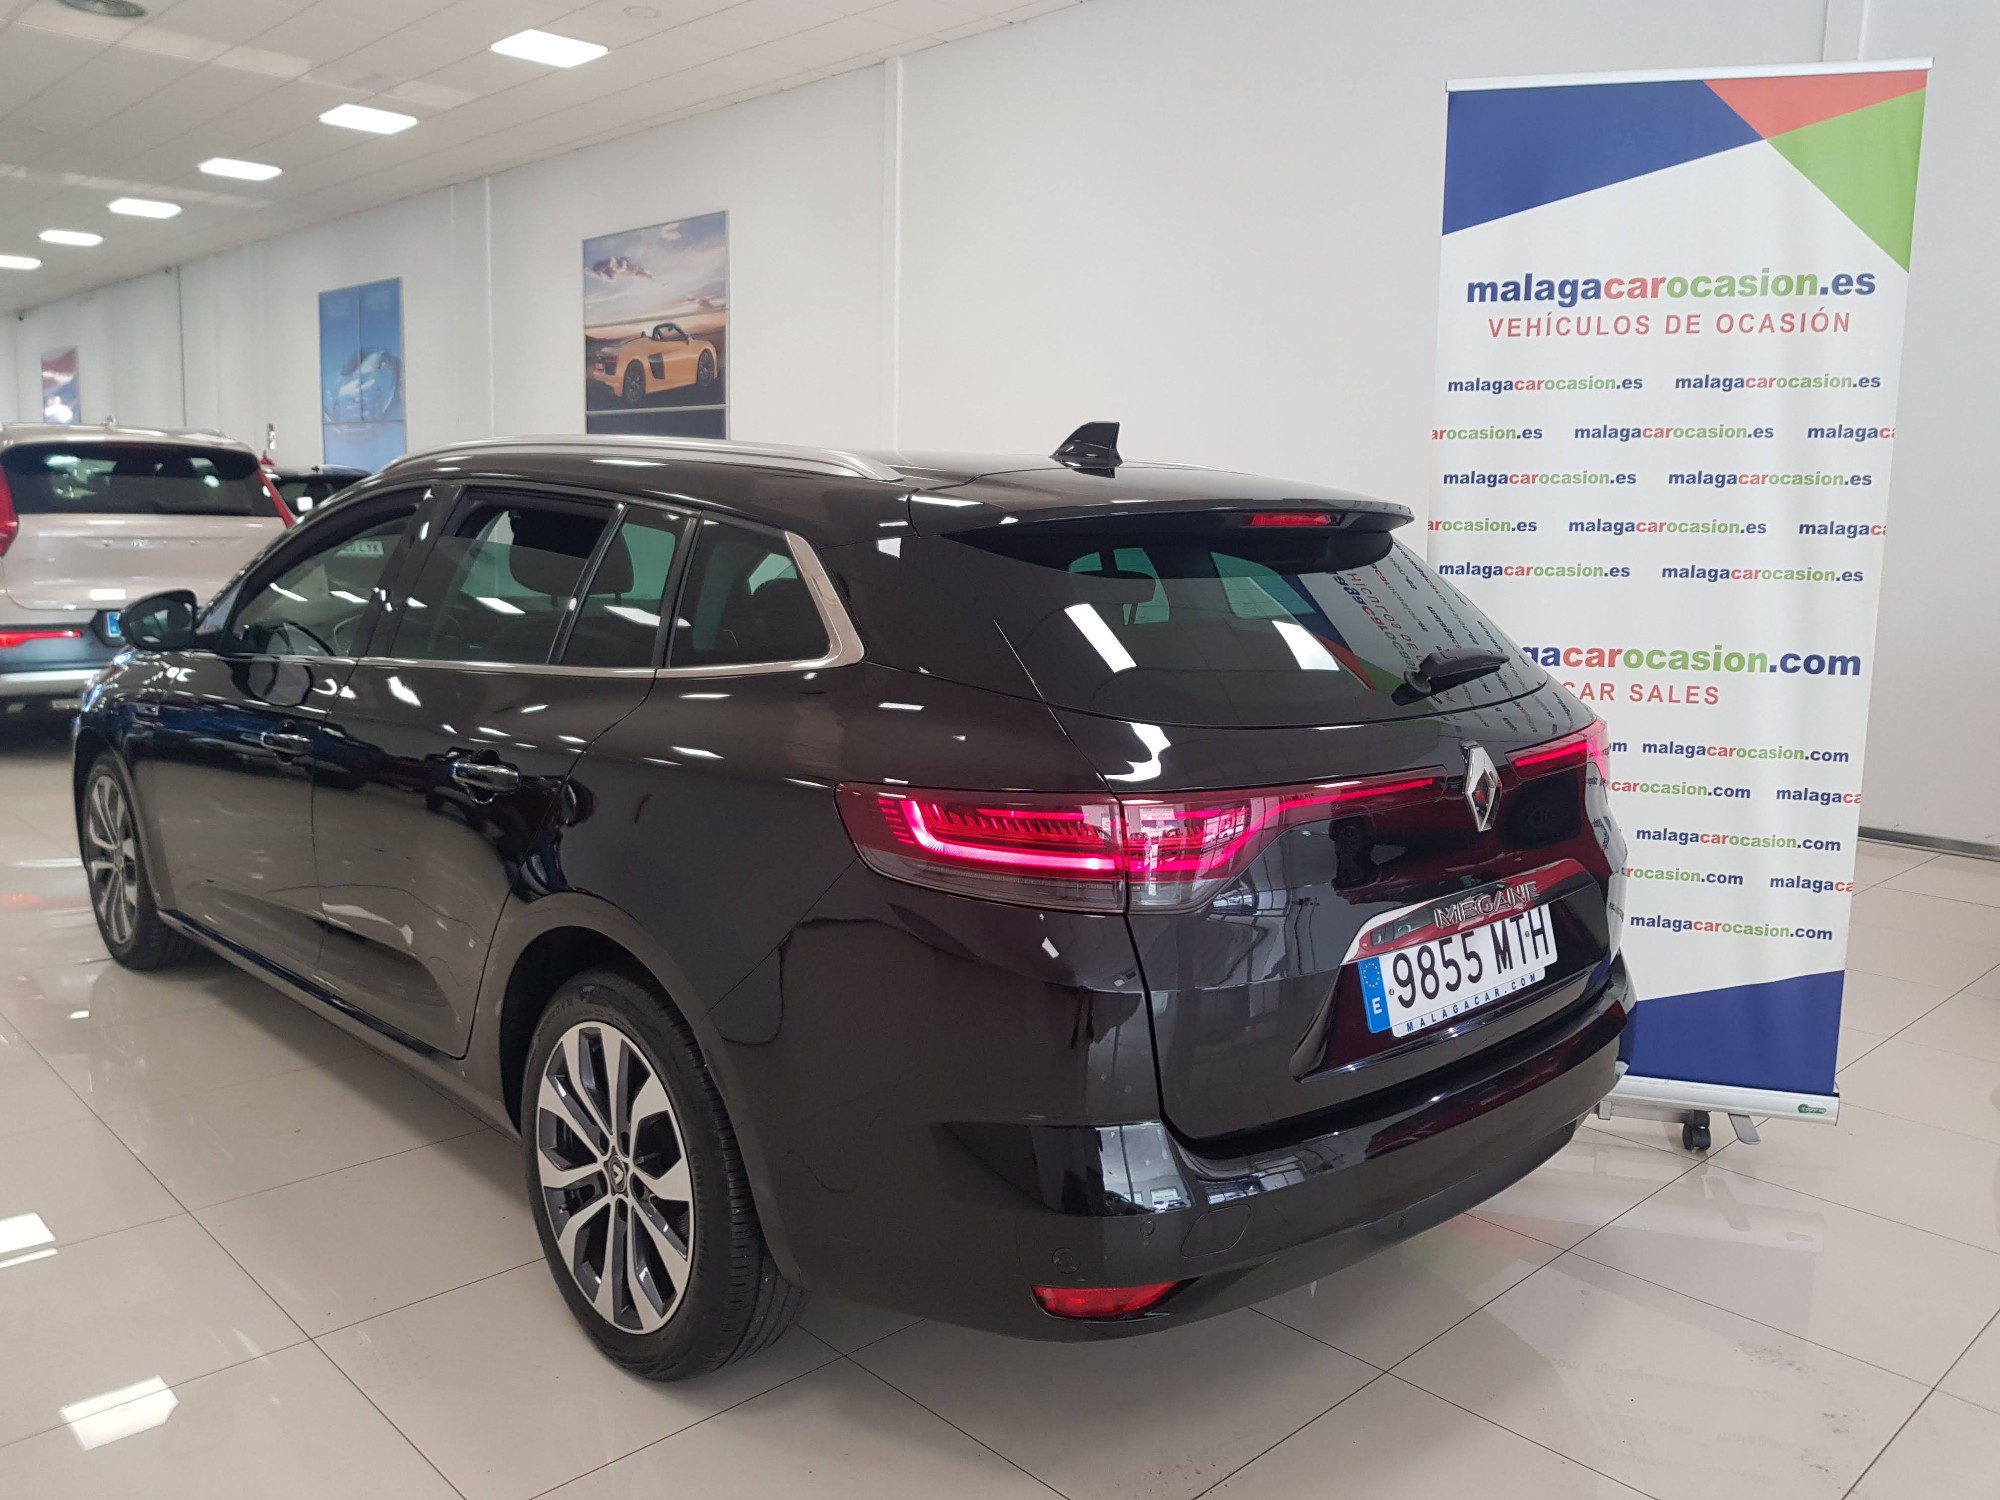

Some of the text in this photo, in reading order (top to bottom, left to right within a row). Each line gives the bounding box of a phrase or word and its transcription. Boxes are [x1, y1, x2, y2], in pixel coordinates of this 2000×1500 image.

[1467, 268, 1876, 308] malagacarocasion.es
[1489, 307, 1850, 338] VEHÍCULOS DE OCASIÓN
[1448, 376, 1643, 395] malagacarocasion.es
[1675, 373, 1881, 393] malagacarocasion.es
[1575, 424, 1774, 442] malagacarocasion.es
[1444, 470, 1636, 488] malagacarocasion.es
[1669, 470, 1872, 488] malagacarocasion.es
[1569, 518, 1766, 537] malagacarocasion.es
[1439, 561, 1631, 582] malagacarocasion.es
[1662, 565, 1863, 583] malagacarocasion.es
[1629, 684, 1719, 705] SALES
[1642, 740, 1849, 763] malagacarocasion.com
[1612, 781, 1751, 799] carocasion.com
[1636, 827, 1841, 852] malagacarocasion.com
[1627, 867, 1744, 886] rocasion.com
[1434, 881, 1540, 928] MEGANE
[1630, 914, 1833, 941] malagacarocasion.com
[1393, 907, 1549, 1008] 9855 MTH
[1371, 997, 1382, 1014] E
[1407, 973, 1536, 1032] MALAGACAR.COM
